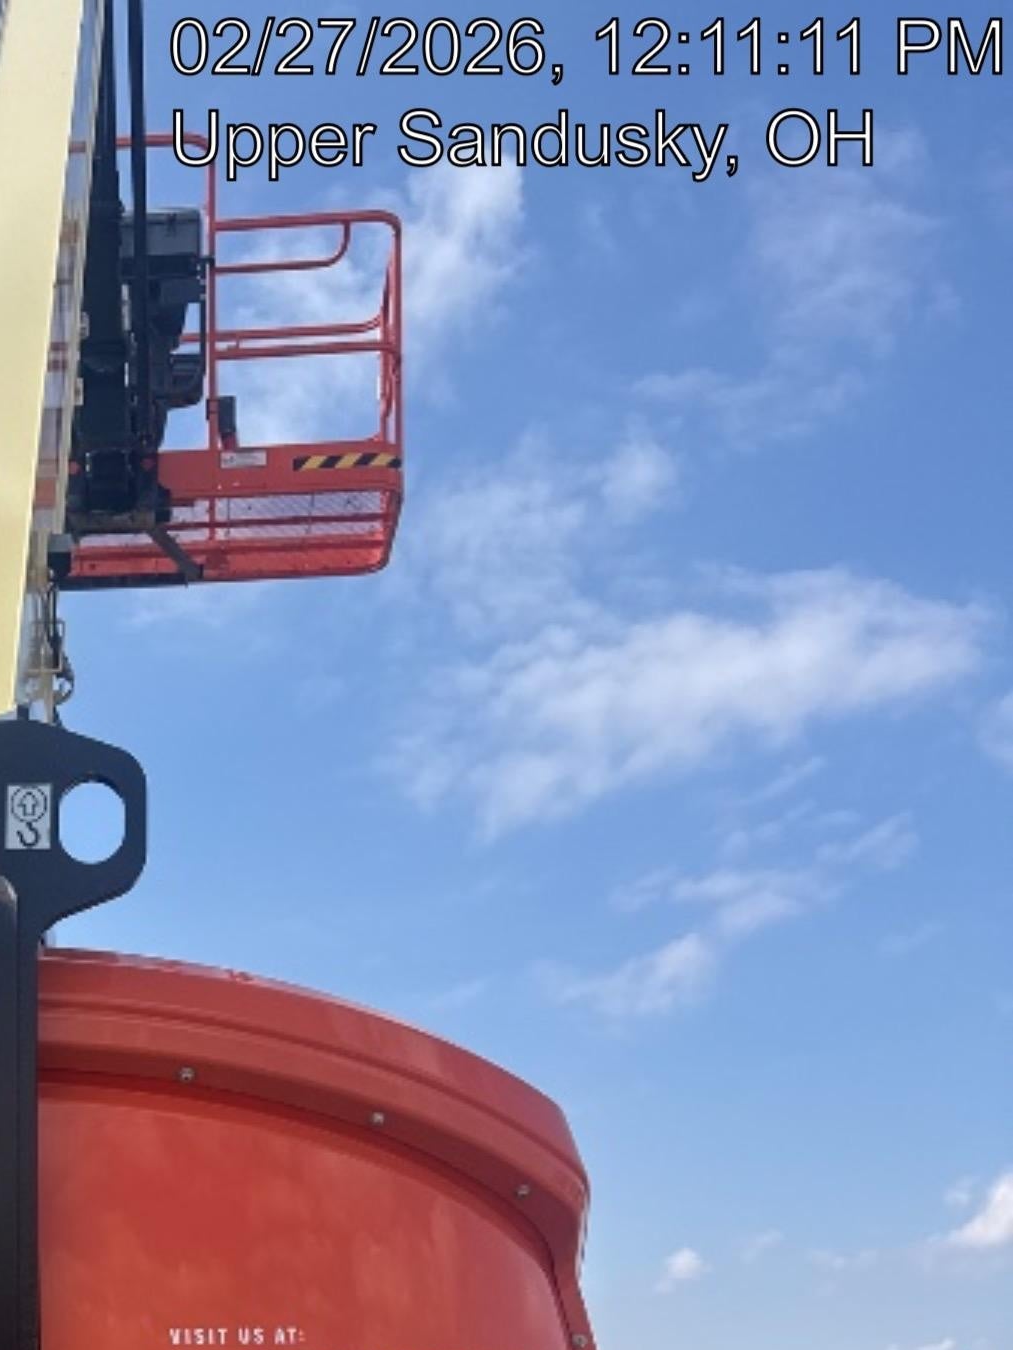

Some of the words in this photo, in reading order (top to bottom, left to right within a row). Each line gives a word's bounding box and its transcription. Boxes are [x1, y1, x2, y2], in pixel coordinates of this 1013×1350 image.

[169, 1327, 228, 1345] VISIT
[238, 1327, 265, 1345] US
[274, 1327, 306, 1345] AT:
